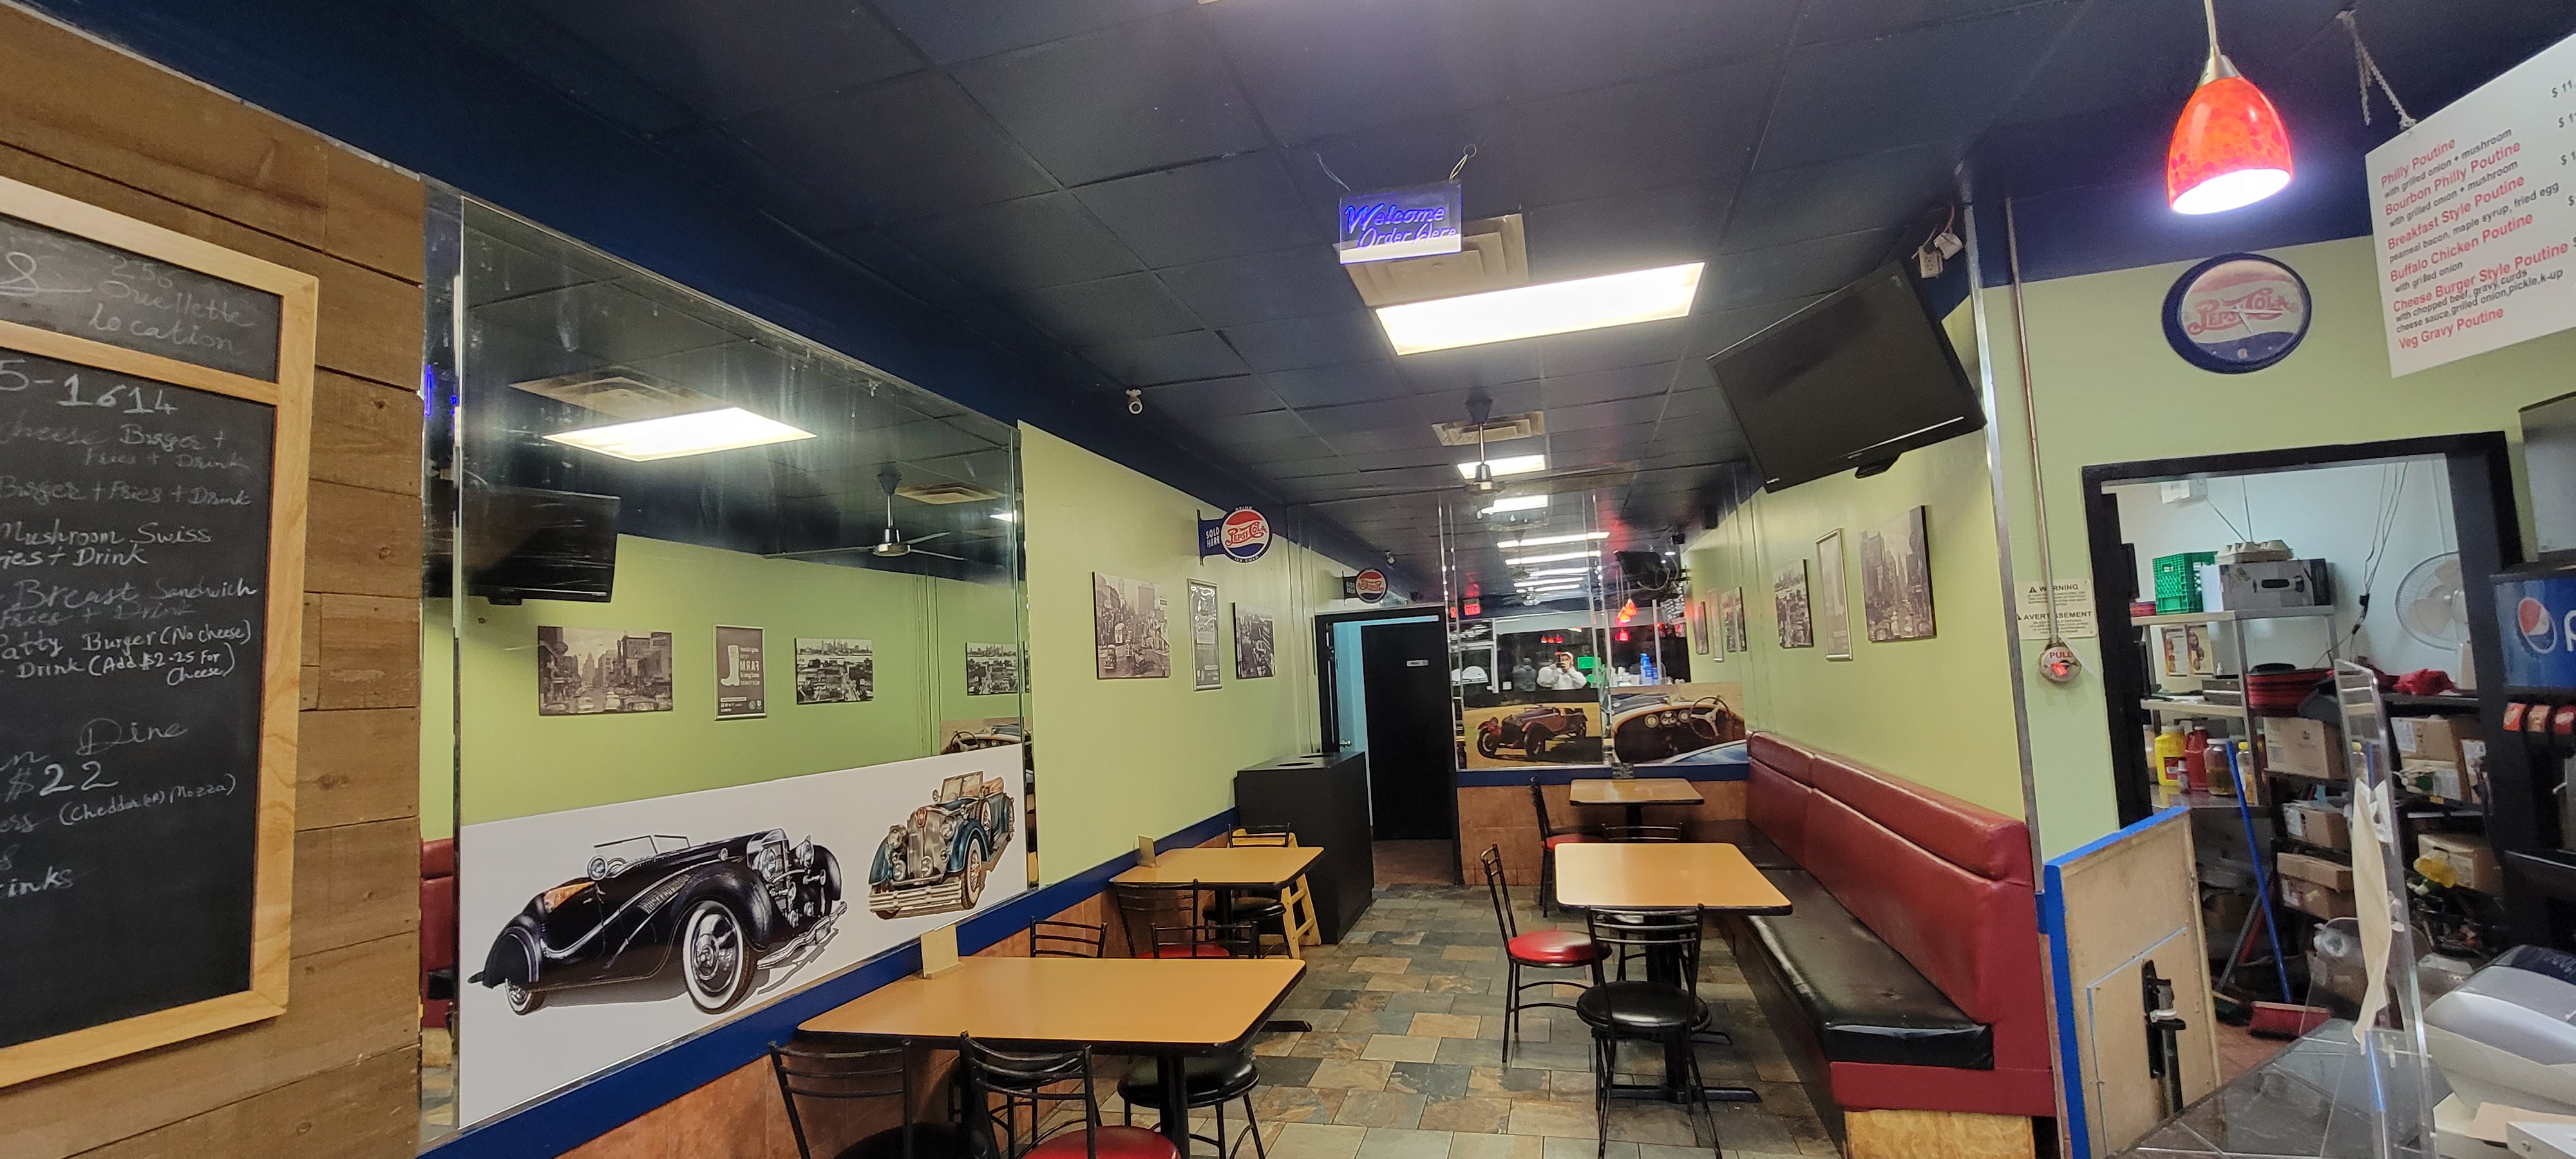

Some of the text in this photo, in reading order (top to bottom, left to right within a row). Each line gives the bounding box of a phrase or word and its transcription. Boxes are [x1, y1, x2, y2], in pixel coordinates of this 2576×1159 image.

[2381, 165, 2409, 188] Philly
[2412, 139, 2455, 169] Poutine
[2384, 185, 2400, 198] with
[2401, 171, 2426, 192] grilled
[2428, 159, 2452, 177] onion
[2461, 128, 2512, 160] mushroom
[2385, 186, 2431, 216] Bourbon
[2434, 168, 2467, 193] Philly
[2470, 140, 2521, 173] Poutine
[2389, 215, 2405, 228] with
[2406, 202, 2431, 221] grilled
[2433, 191, 2457, 207] onion
[2468, 160, 2518, 191] mushroom
[1345, 203, 1445, 234] Welcome
[2388, 216, 2439, 250] Breakfast
[2441, 202, 2471, 223] Style
[2474, 176, 2524, 207] Poutine
[2389, 182, 2559, 264] peameal bacon, maple syrup, fried egg
[1358, 222, 1457, 250] Order Here
[2390, 259, 2428, 282] Buffalo
[2430, 236, 2479, 264] Chicken
[2482, 213, 2533, 243] Poutine
[2393, 291, 2432, 312] Cheese
[2436, 276, 2476, 298] Burger
[2479, 263, 2511, 283] Style
[2514, 242, 2568, 270] Poutine
[2394, 281, 2410, 292] with
[2439, 261, 2463, 276] onion
[2396, 311, 2412, 322] with
[2412, 297, 2448, 316] chopped
[2396, 319, 2423, 333] cheese
[2398, 307, 2504, 349] Veg Gravy Poutine
[130, 522, 211, 544] Swiss
[1206, 527, 1220, 540] SOLD
[1206, 536, 1220, 549] HERE
[1225, 522, 1267, 546] PEPSI COLA
[73, 544, 148, 566] Drink
[150, 578, 257, 599] Sandwich
[82, 631, 156, 657] Burger
[16, 657, 84, 678] Drink
